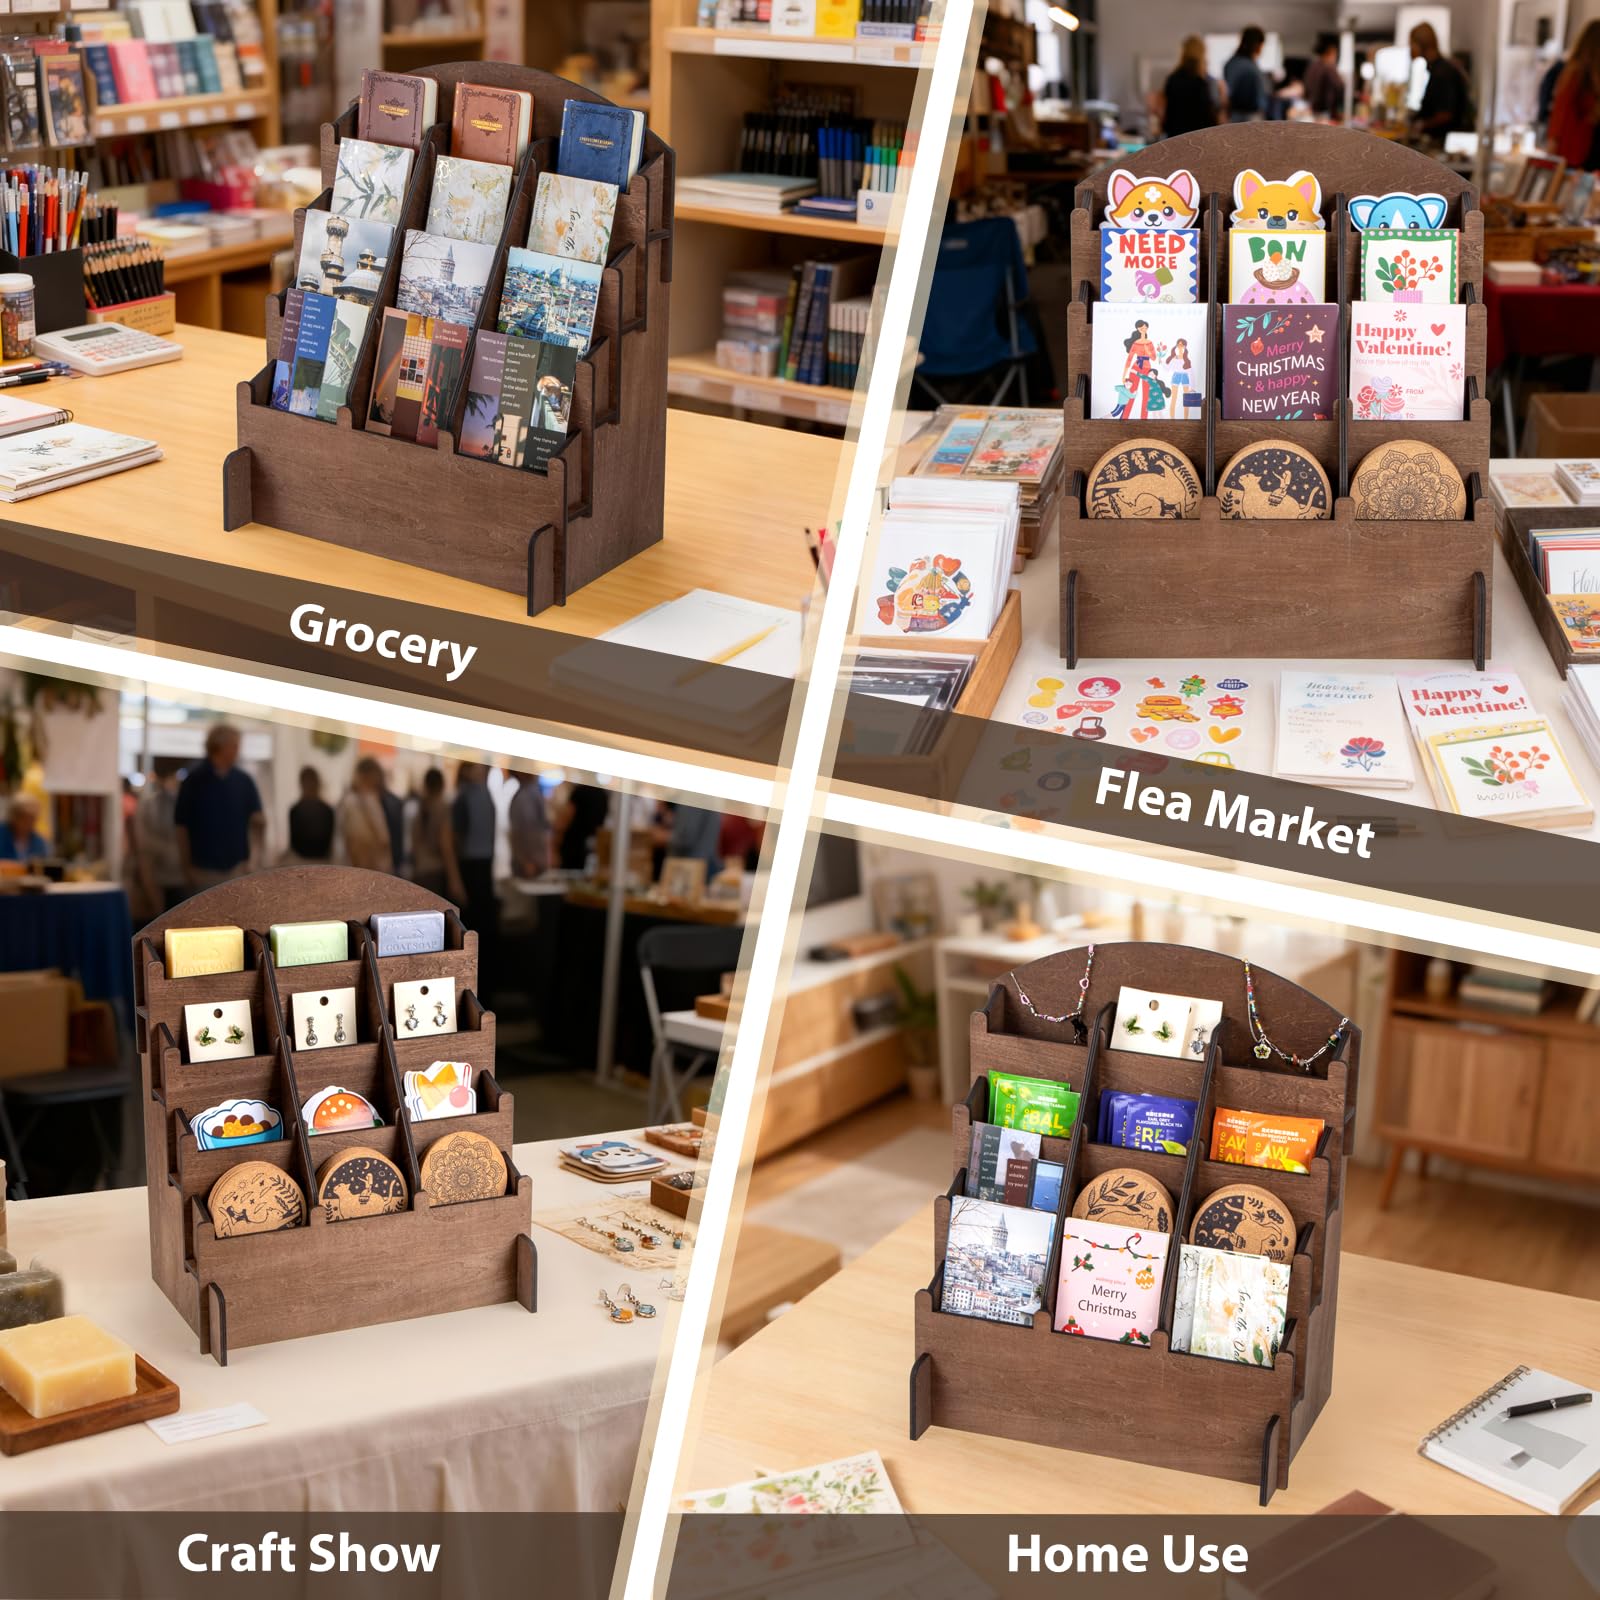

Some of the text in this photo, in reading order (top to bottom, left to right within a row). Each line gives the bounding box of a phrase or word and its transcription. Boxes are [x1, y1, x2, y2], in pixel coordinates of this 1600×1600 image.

[1120, 234, 1186, 255] NEED
[1248, 237, 1307, 263] BON
[1124, 255, 1178, 270] MORE
[1356, 323, 1417, 341] Happy
[1267, 341, 1304, 357] Merry
[1356, 341, 1452, 356] Valentine!
[1237, 355, 1325, 377] CHRISTMAS
[1255, 374, 1308, 392] & happy
[1242, 391, 1321, 413] NEW YEAR
[1412, 689, 1482, 703] Happy
[1414, 697, 1528, 717] Valentine!
[386, 941, 437, 952] GOAT SOAP
[1029, 1110, 1064, 1130] BAL
[1264, 1144, 1290, 1160] AW
[1092, 1284, 1127, 1303] Merry
[1238, 1286, 1251, 1314] Save
[1078, 1300, 1137, 1320] Christmas
[1236, 1317, 1248, 1332] the
